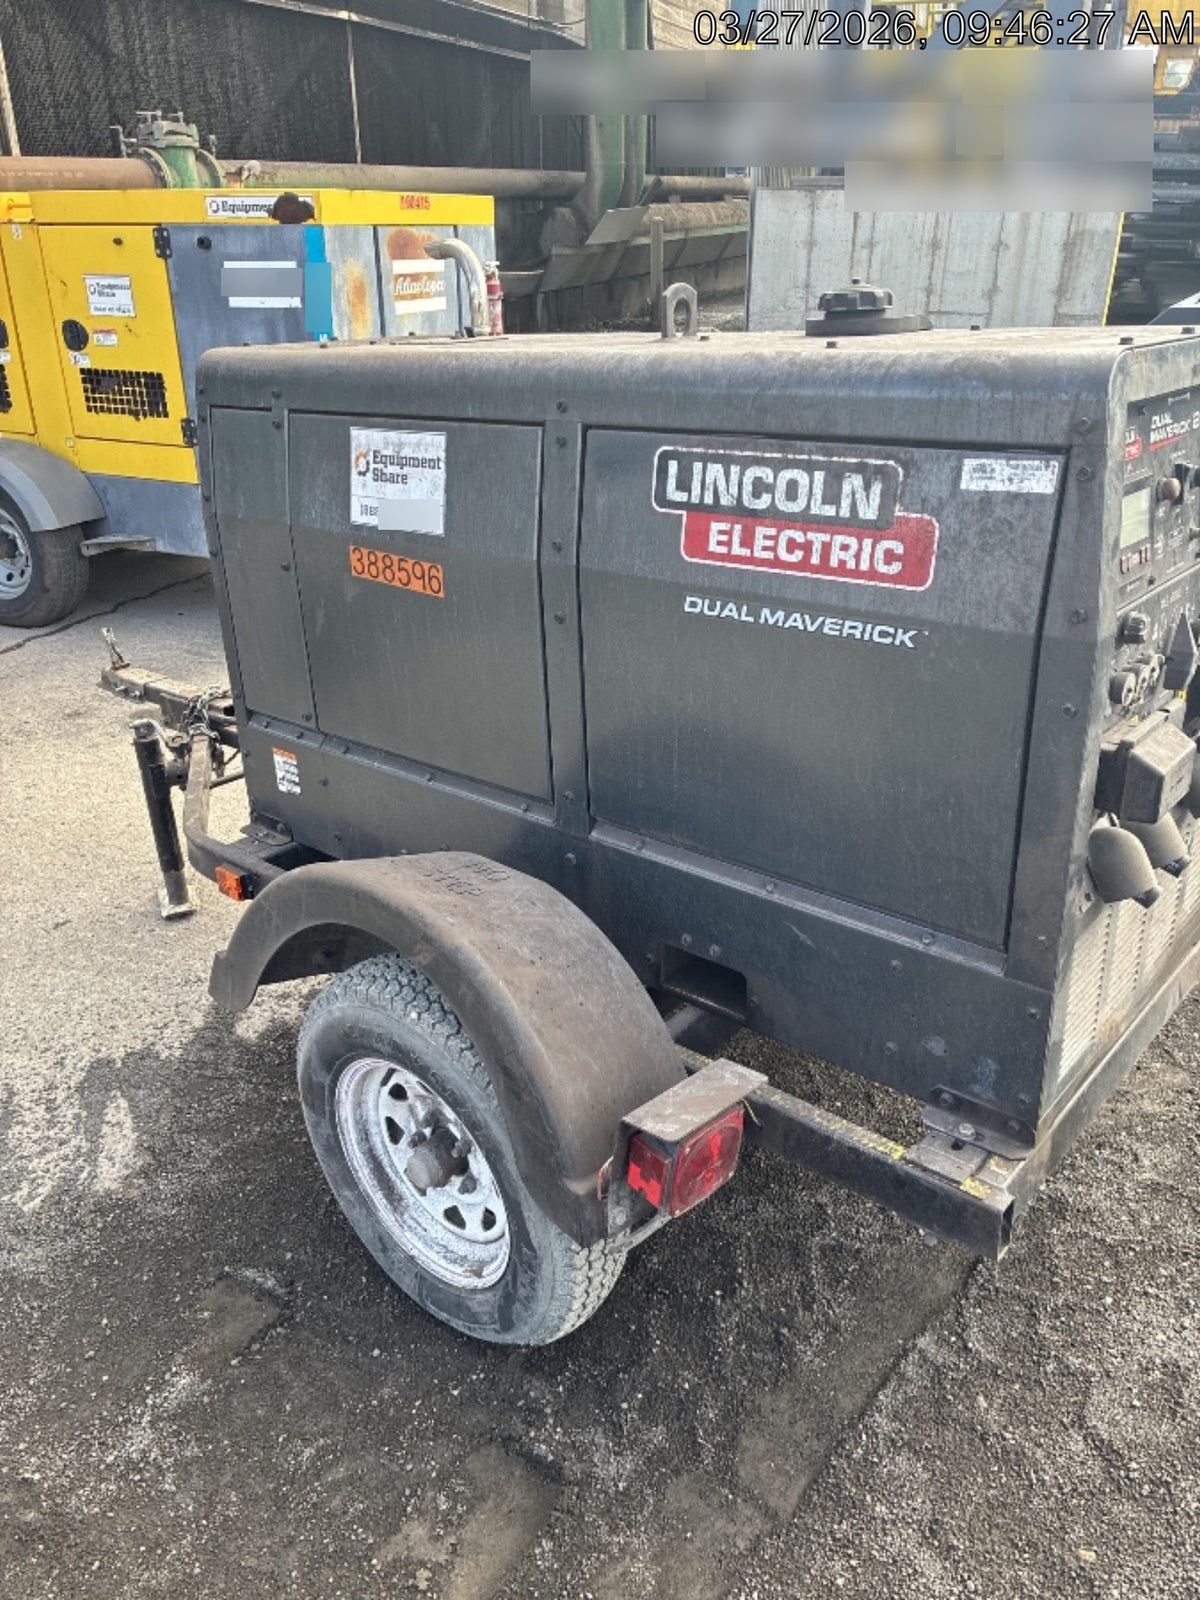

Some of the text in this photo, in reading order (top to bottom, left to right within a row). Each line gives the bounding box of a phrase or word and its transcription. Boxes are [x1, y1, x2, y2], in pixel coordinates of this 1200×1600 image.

[372, 450, 442, 470] Equipment
[372, 469, 408, 485] Share
[665, 459, 883, 520] LINCOLN
[351, 546, 442, 595] 388596
[707, 521, 904, 576] ELECTRIC
[683, 596, 919, 648] DUAL MAVERICK
